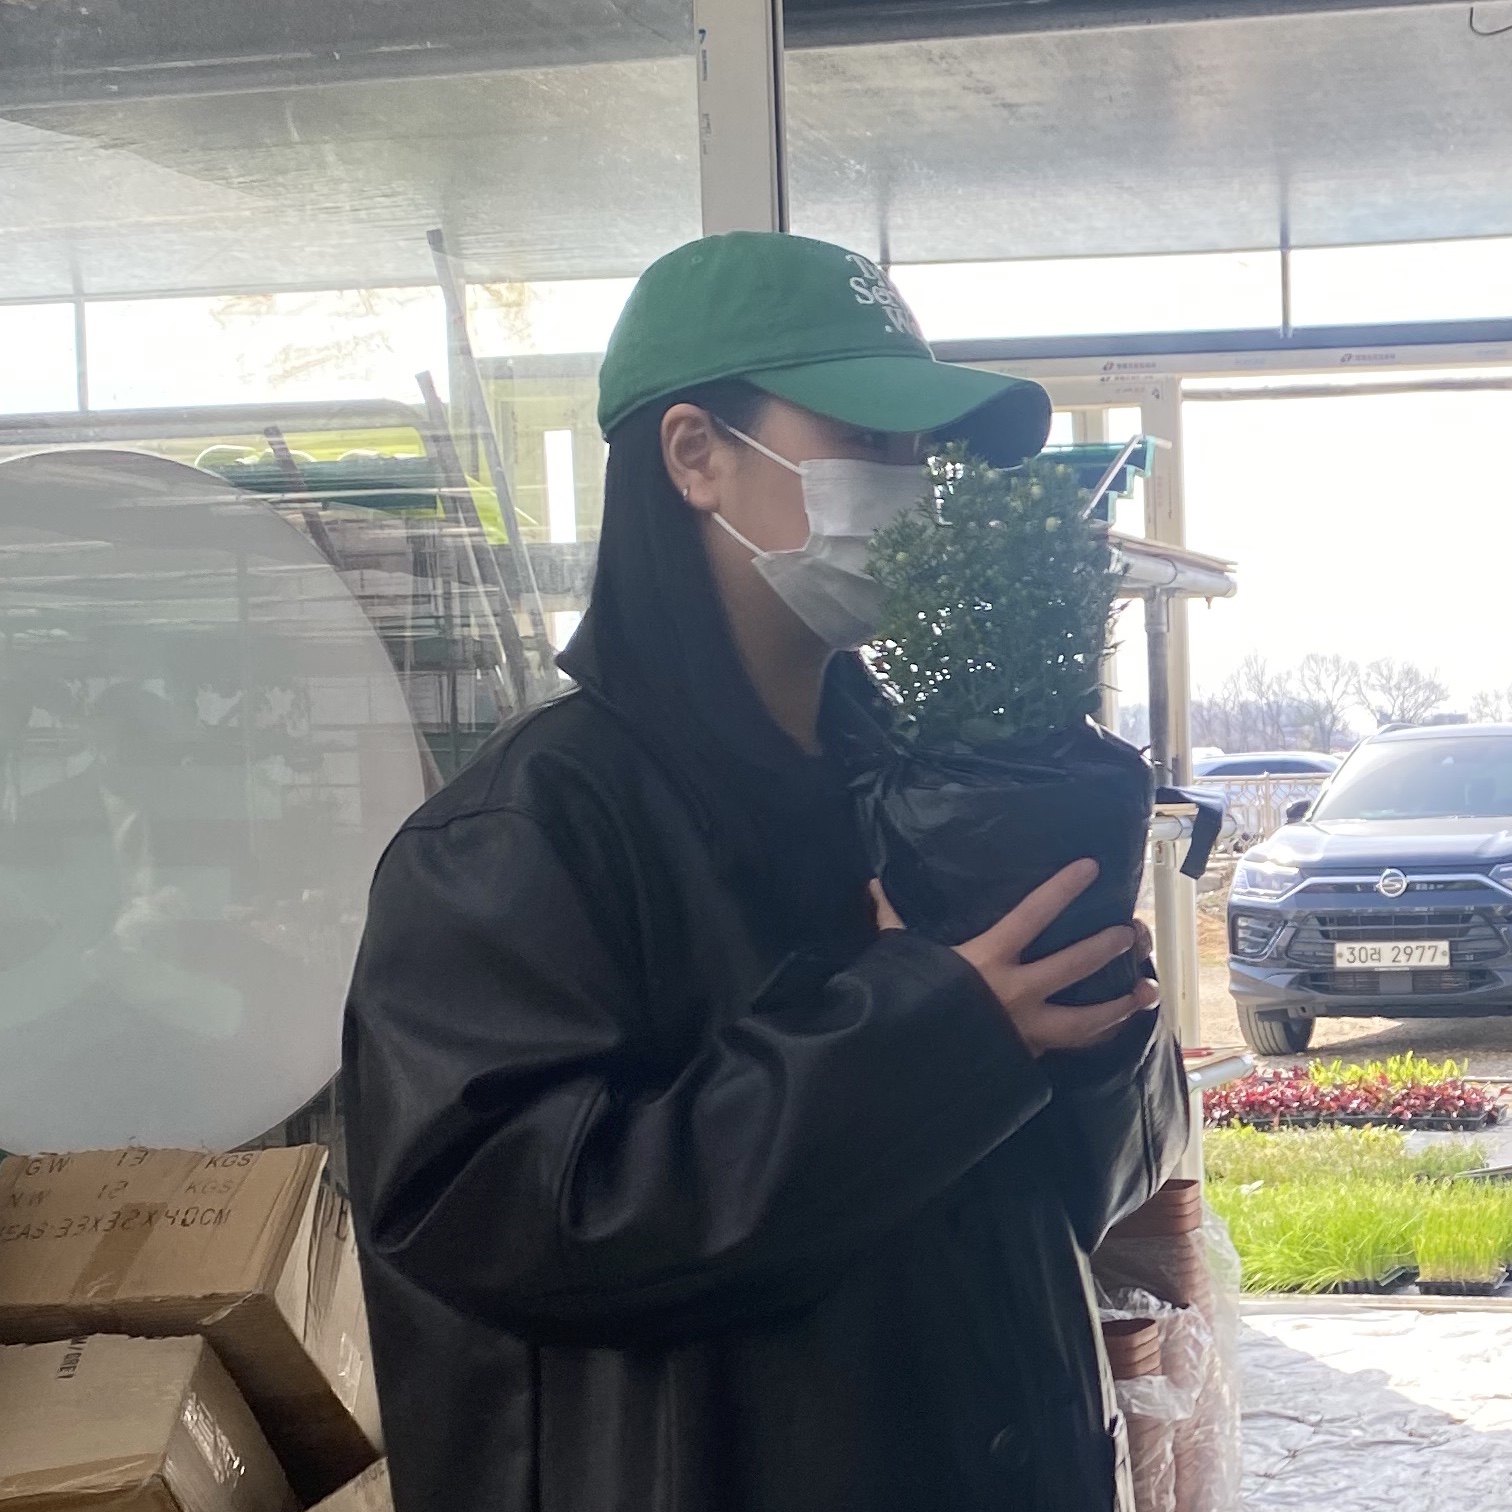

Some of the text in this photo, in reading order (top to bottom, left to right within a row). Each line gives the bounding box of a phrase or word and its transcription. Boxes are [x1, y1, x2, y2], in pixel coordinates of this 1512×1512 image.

[1391, 944, 1438, 963] 2977
[205, 1153, 251, 1169] KGS
[186, 1180, 234, 1194] KGS
